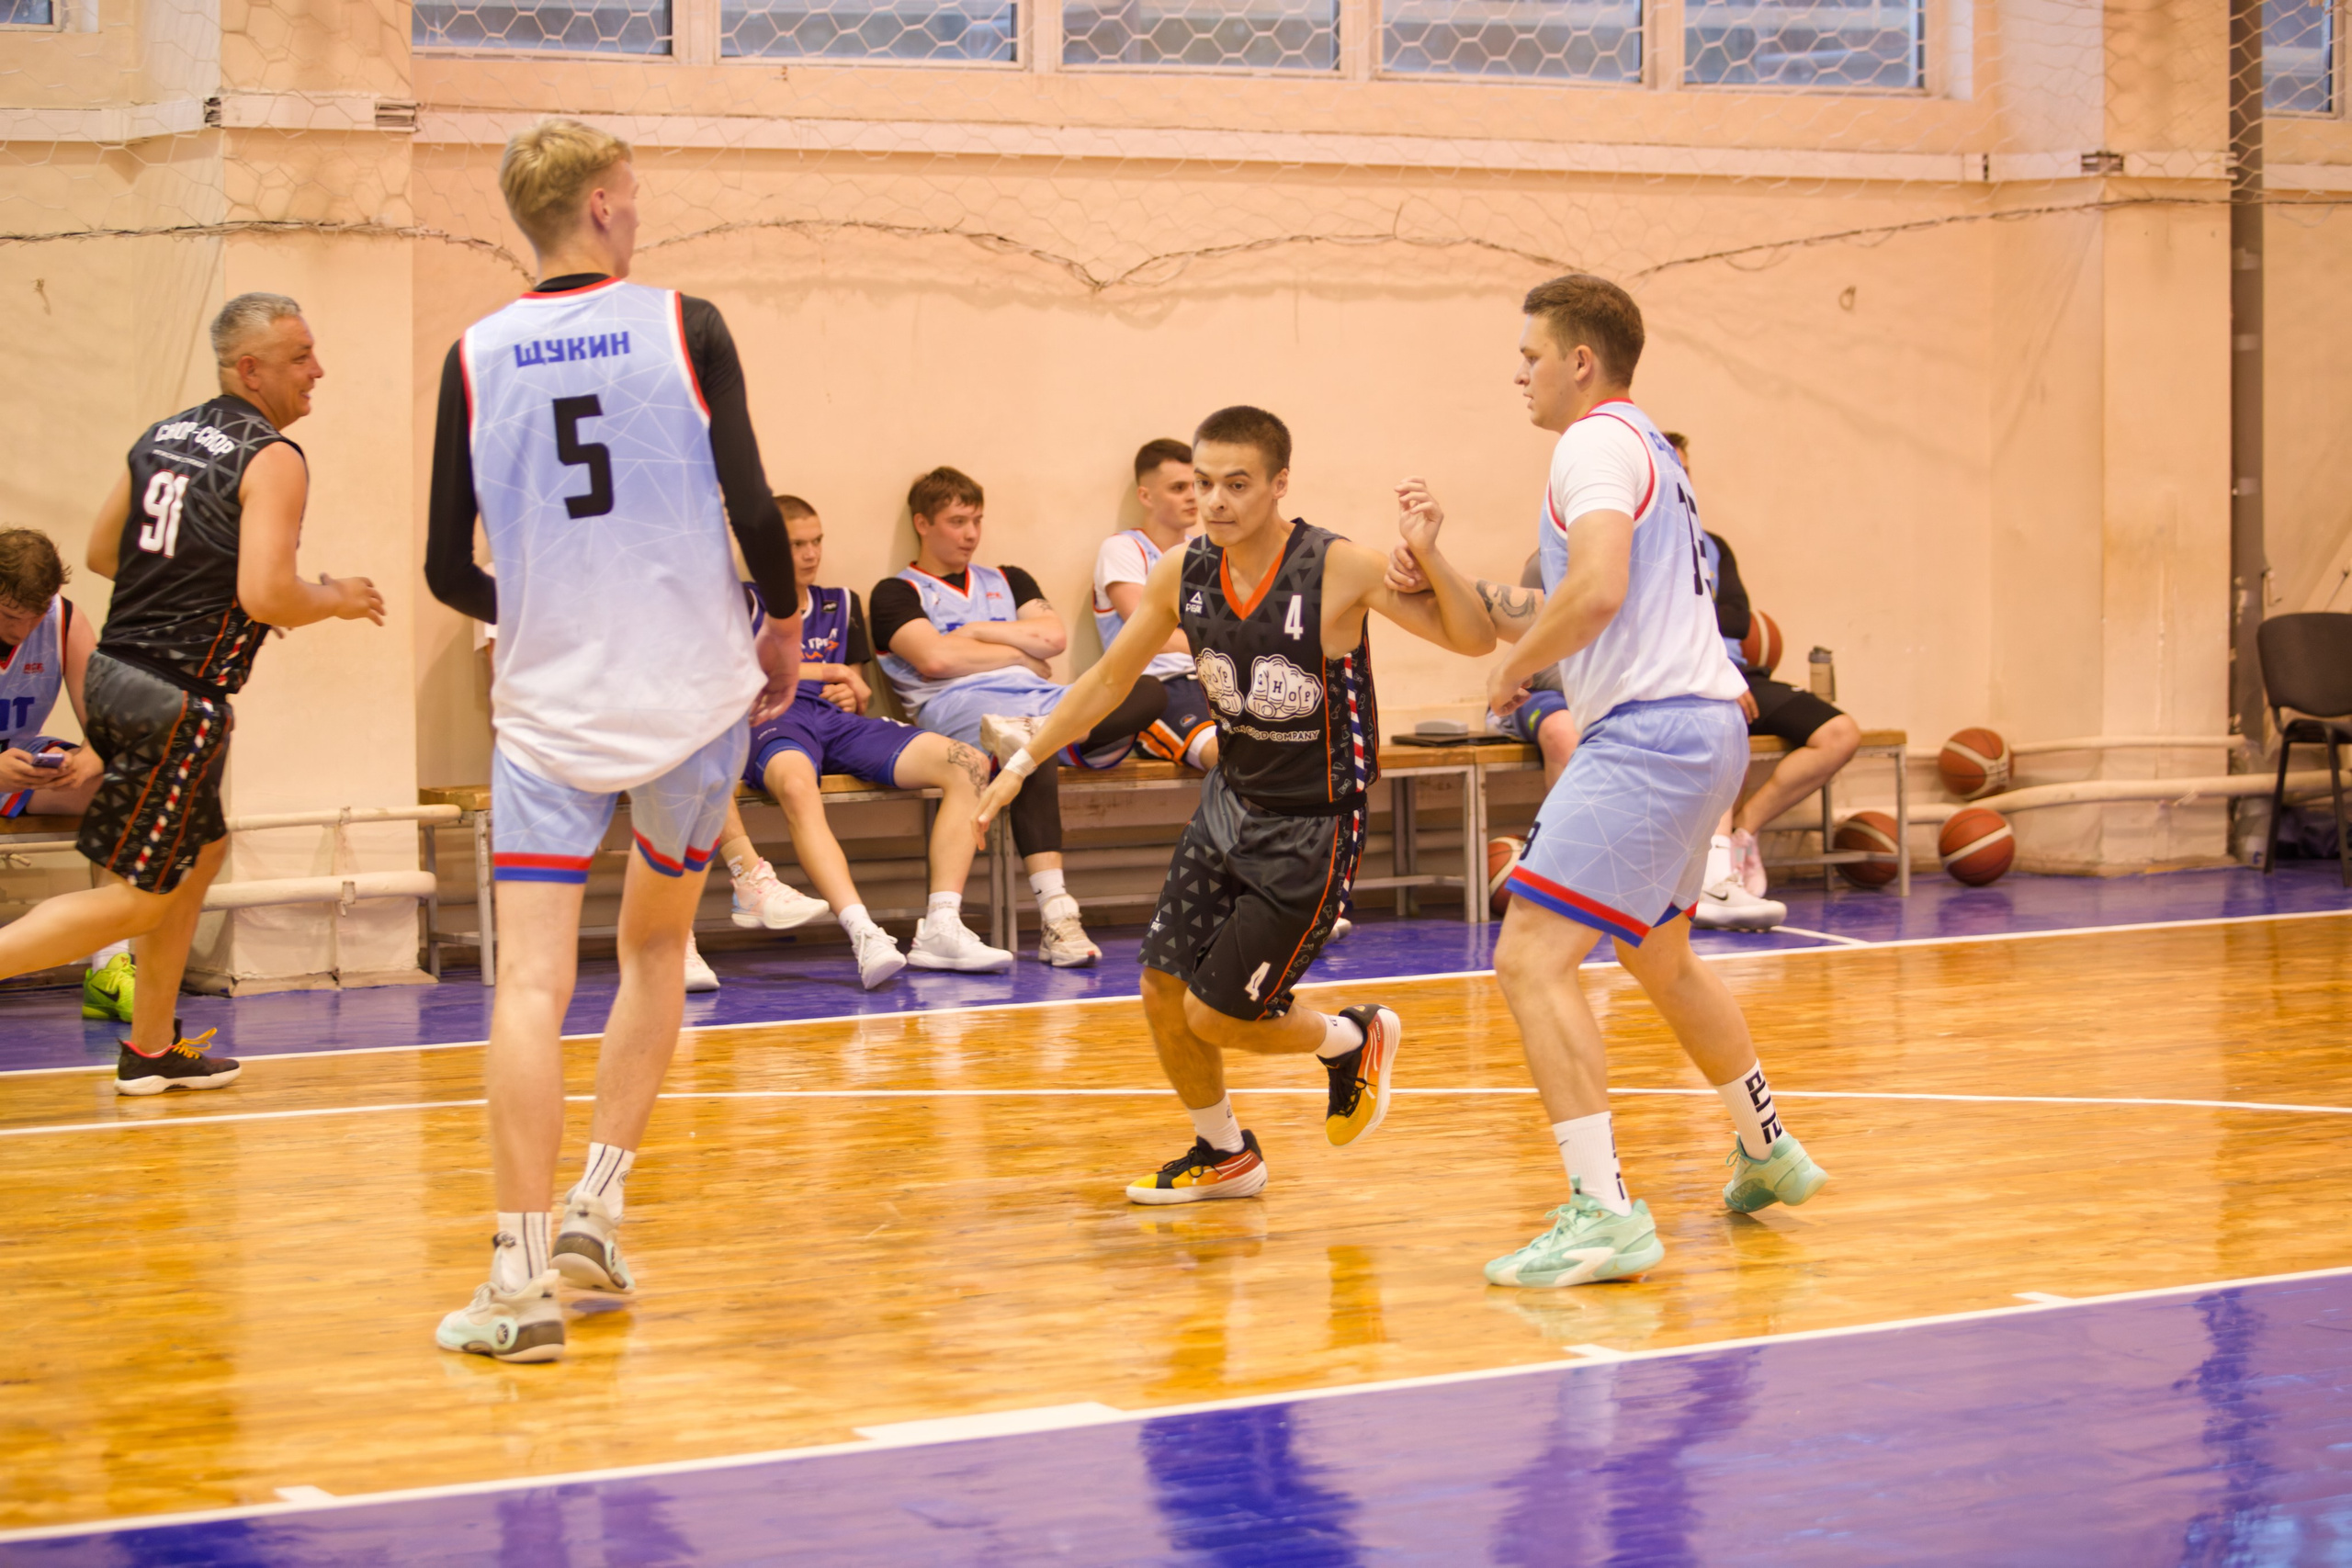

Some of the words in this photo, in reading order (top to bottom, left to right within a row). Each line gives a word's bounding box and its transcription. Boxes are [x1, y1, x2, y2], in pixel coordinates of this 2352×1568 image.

[514, 331, 630, 367] ЩУКИН
[552, 394, 615, 519] 5
[138, 468, 191, 558] 91
[1283, 593, 1304, 641] 4
[1269, 729, 1320, 742] COMPANY
[1244, 961, 1272, 1002] 4
